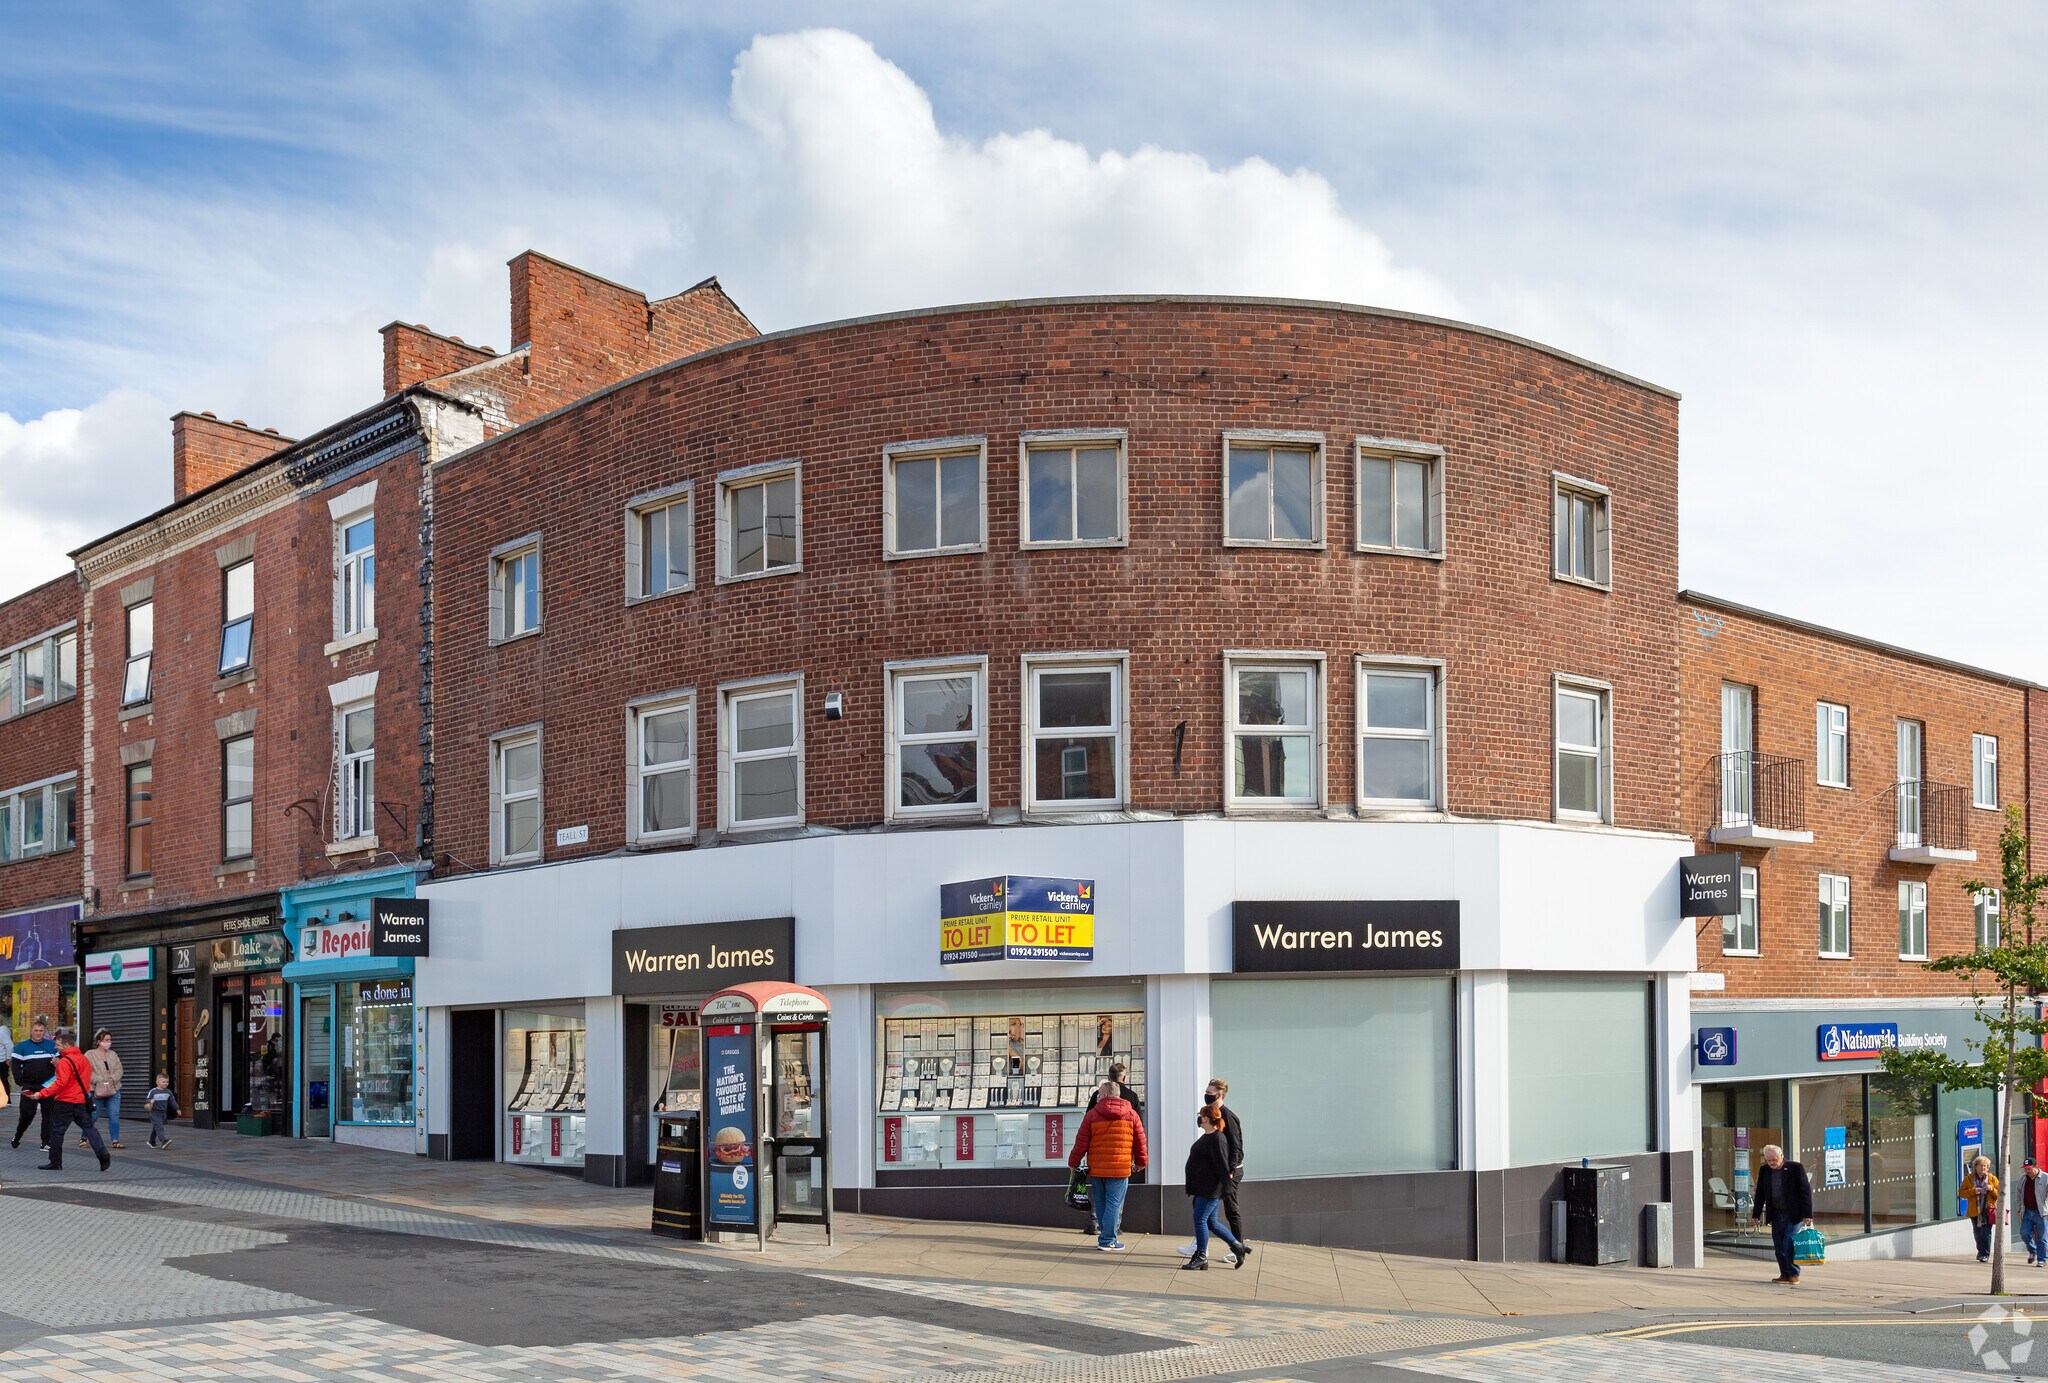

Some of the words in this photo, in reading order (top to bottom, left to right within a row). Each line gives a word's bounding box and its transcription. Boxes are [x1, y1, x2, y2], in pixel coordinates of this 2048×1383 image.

[559, 831, 576, 841] TEALL
[580, 830, 586, 838] ST
[1686, 873, 1731, 886] Warren
[970, 893, 994, 904] Vickers
[1048, 891, 1078, 902] Vickers
[1689, 888, 1728, 900] James
[980, 899, 1002, 911] carnley
[1060, 900, 1090, 914] carnley
[224, 920, 236, 930] PETES
[238, 917, 250, 928] SHOE
[252, 916, 270, 926] REPAIRS
[380, 913, 424, 926] Warren
[944, 920, 958, 928] PRIME
[976, 916, 988, 924] UNIT
[1032, 914, 1053, 922] RETAIL
[383, 930, 421, 943] James
[944, 928, 964, 948] TO
[968, 926, 992, 946] LET
[1011, 924, 1038, 944] TO
[1046, 925, 1076, 944] LET
[1254, 924, 1352, 950] Warren
[1362, 924, 1443, 948] James
[233, 938, 260, 956] Loake
[1010, 948, 1032, 956] 01924
[1033, 948, 1058, 957] 291500
[178, 948, 190, 968] 28
[625, 950, 700, 973] Warren
[706, 945, 774, 968] James
[944, 952, 959, 961] 01924
[960, 951, 978, 960] 291500
[214, 960, 232, 970] Quality
[234, 957, 262, 968] Handmade
[264, 956, 280, 964] Shoes
[362, 990, 371, 1001] rs
[374, 984, 398, 1000] done
[400, 982, 410, 998] in
[716, 1001, 741, 1010] Teleone
[780, 996, 810, 1006] Telephone
[662, 1012, 699, 1026] SAL
[1840, 1029, 1896, 1050] Nationwide
[1898, 1034, 1922, 1048] Building
[1924, 1032, 1947, 1048] Society
[675, 1059, 699, 1074] SAL
[724, 1065, 736, 1075] THE
[716, 1073, 744, 1086] NATION'S
[716, 1082, 746, 1097] FAVOURITE
[718, 1094, 736, 1106] TASTE
[738, 1092, 746, 1102] OF
[720, 1103, 745, 1116] NORMAL
